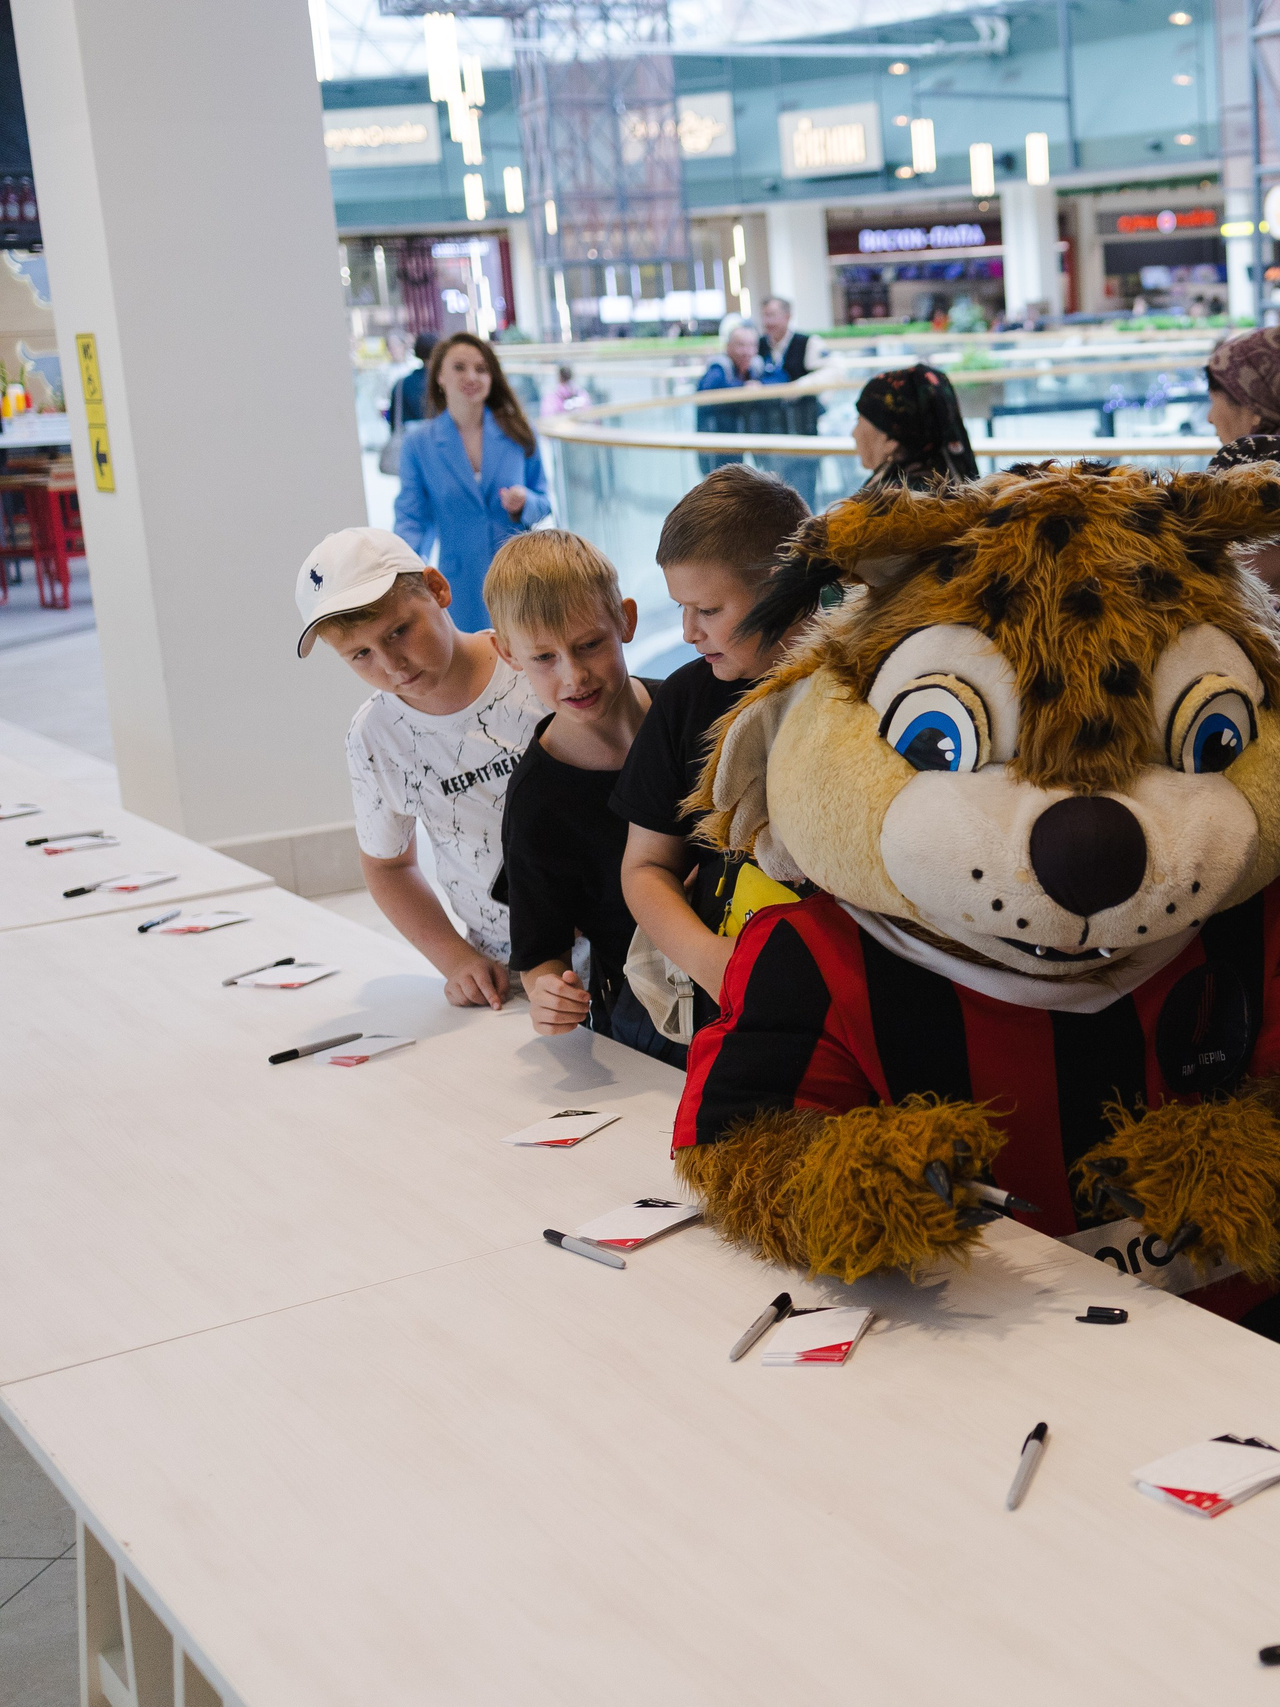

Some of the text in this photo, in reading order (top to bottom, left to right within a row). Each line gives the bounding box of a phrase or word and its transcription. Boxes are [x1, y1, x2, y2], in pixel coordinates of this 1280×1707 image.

[440, 771, 475, 796] KEEP
[475, 764, 491, 783] IT
[1198, 1049, 1226, 1065] ПЕРМЬ
